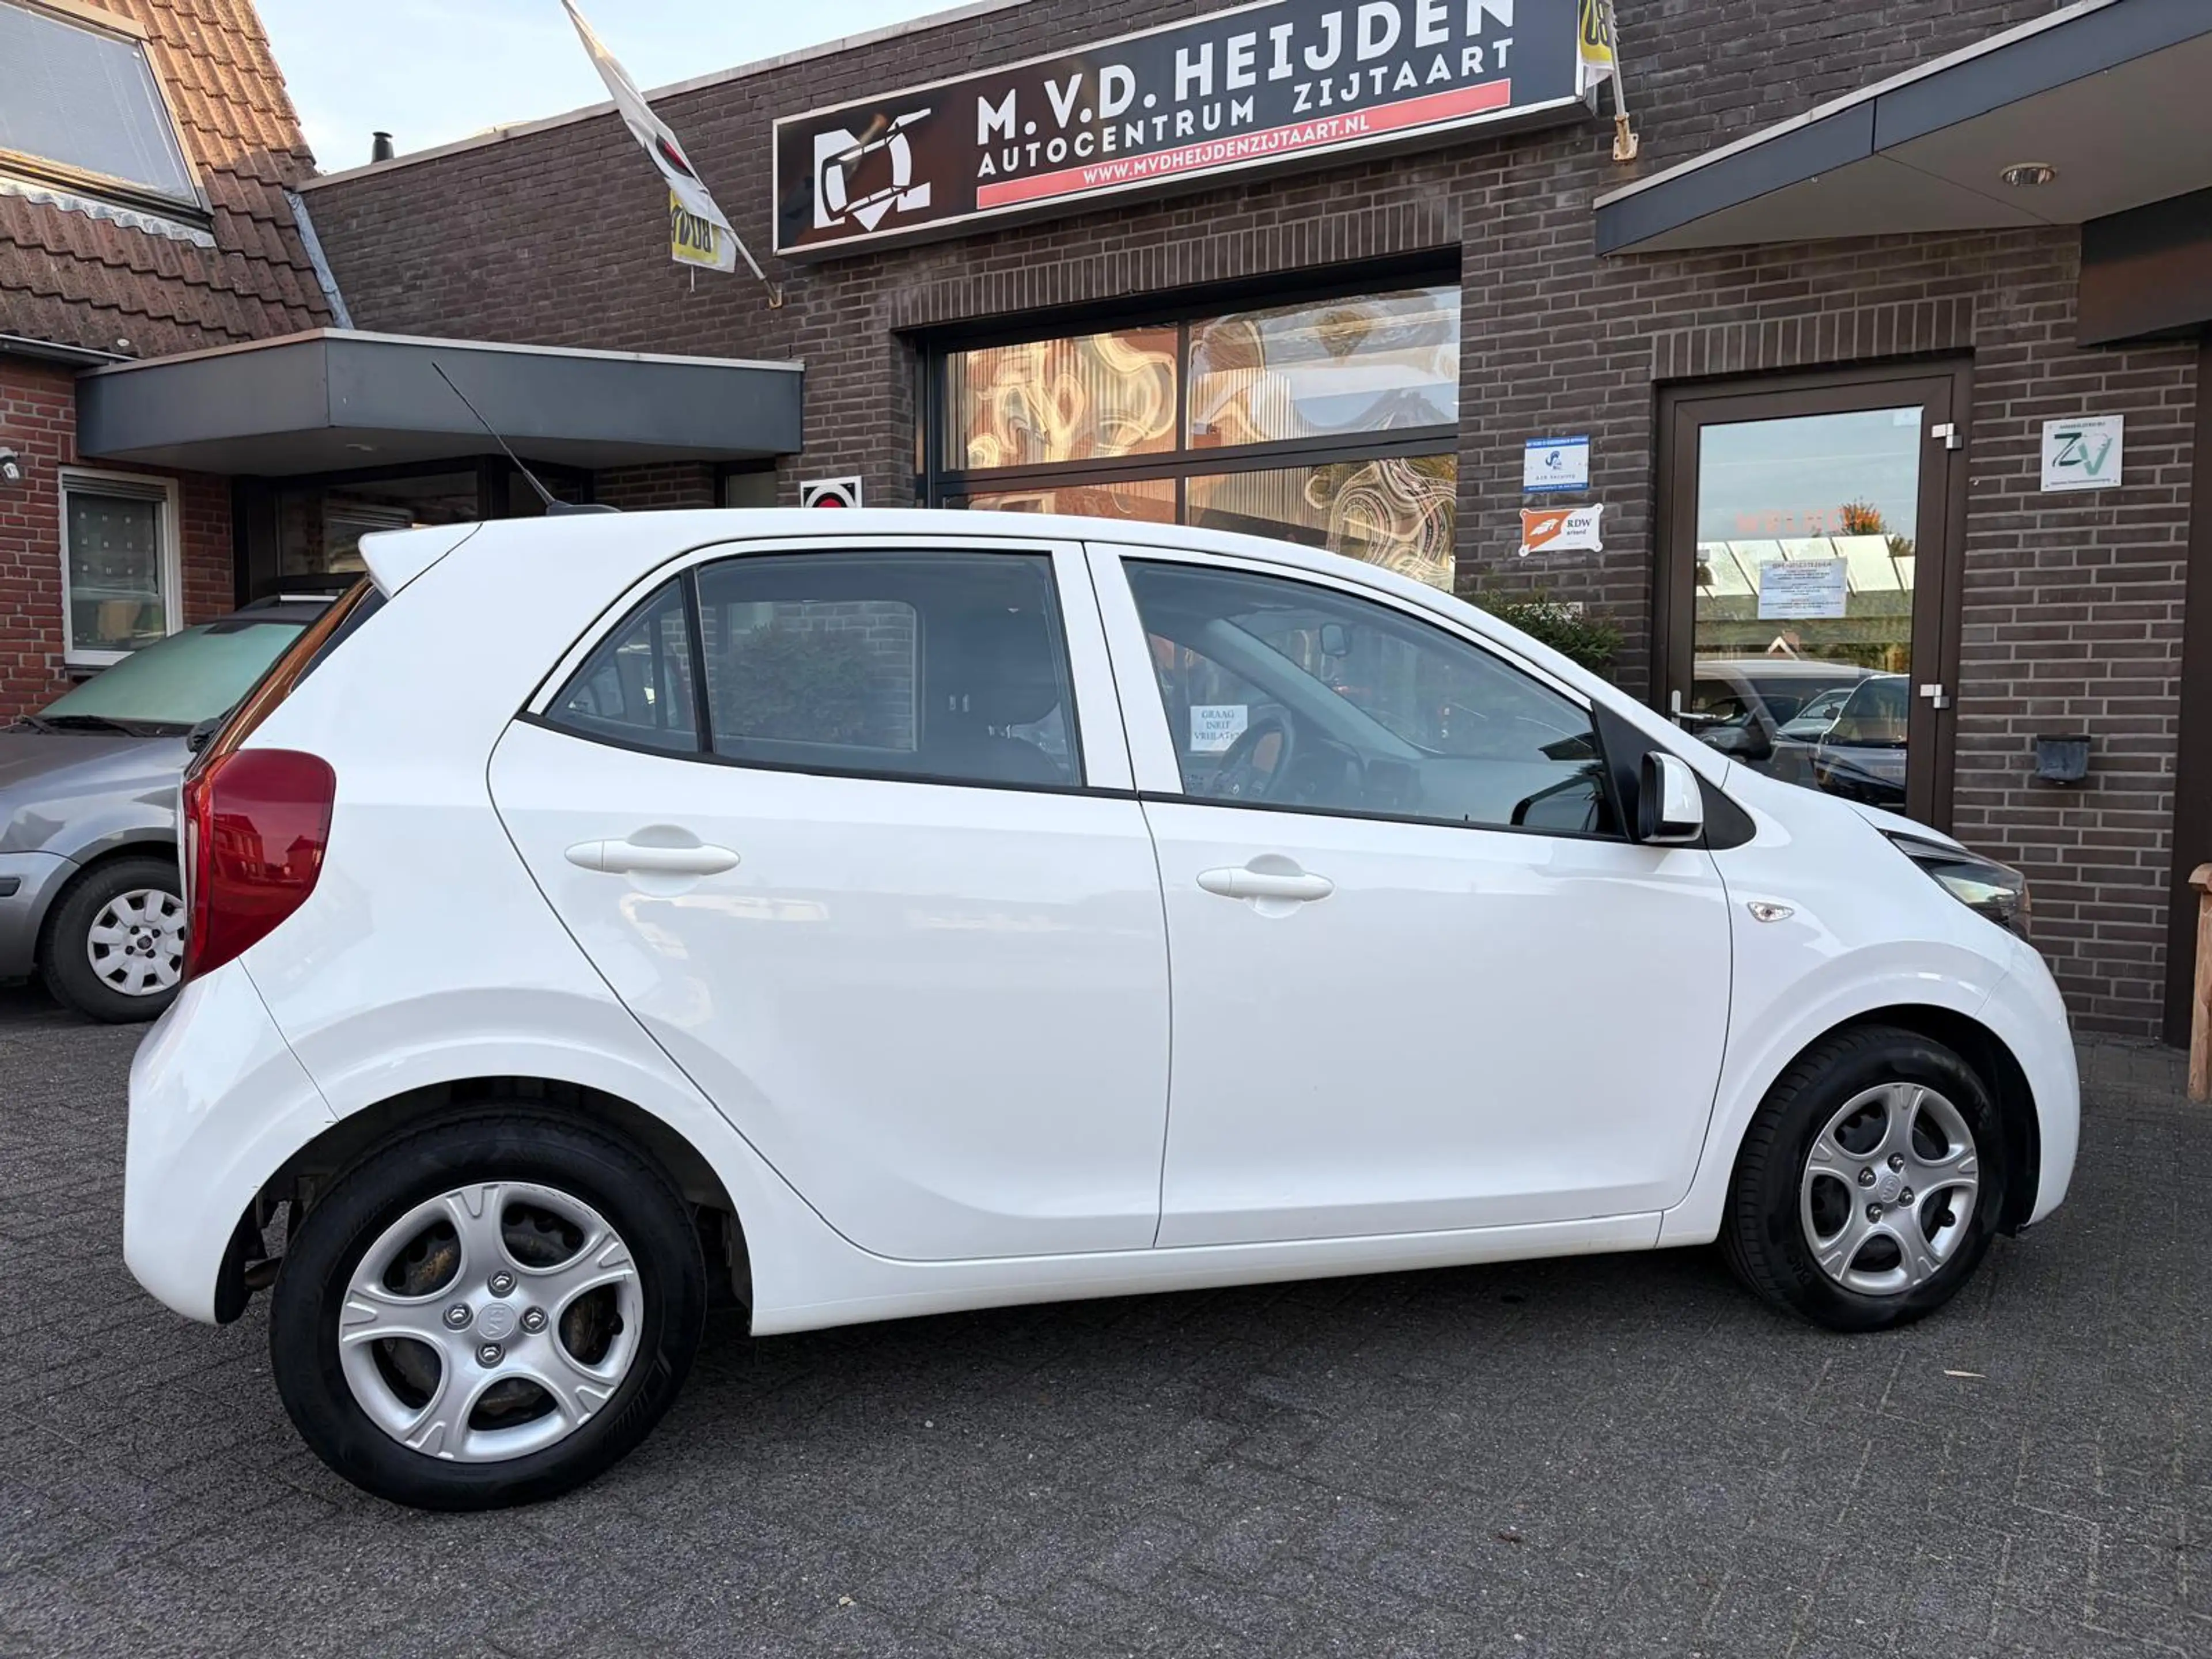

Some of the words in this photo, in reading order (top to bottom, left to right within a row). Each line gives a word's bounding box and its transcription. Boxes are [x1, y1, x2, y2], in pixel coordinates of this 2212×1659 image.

[977, 64, 1157, 145] M.V.D.
[1175, 0, 1513, 102] HEIJDEN
[977, 96, 1253, 177] AUTOCENTRUM
[1293, 38, 1513, 114] ZIJTAART
[1083, 115, 1370, 184] WWW.MVDHEIJDENZIJTAART.NL
[2051, 431, 2113, 476] ZV
[1567, 518, 1592, 528] RDW
[1201, 709, 1234, 719] GRAAG
